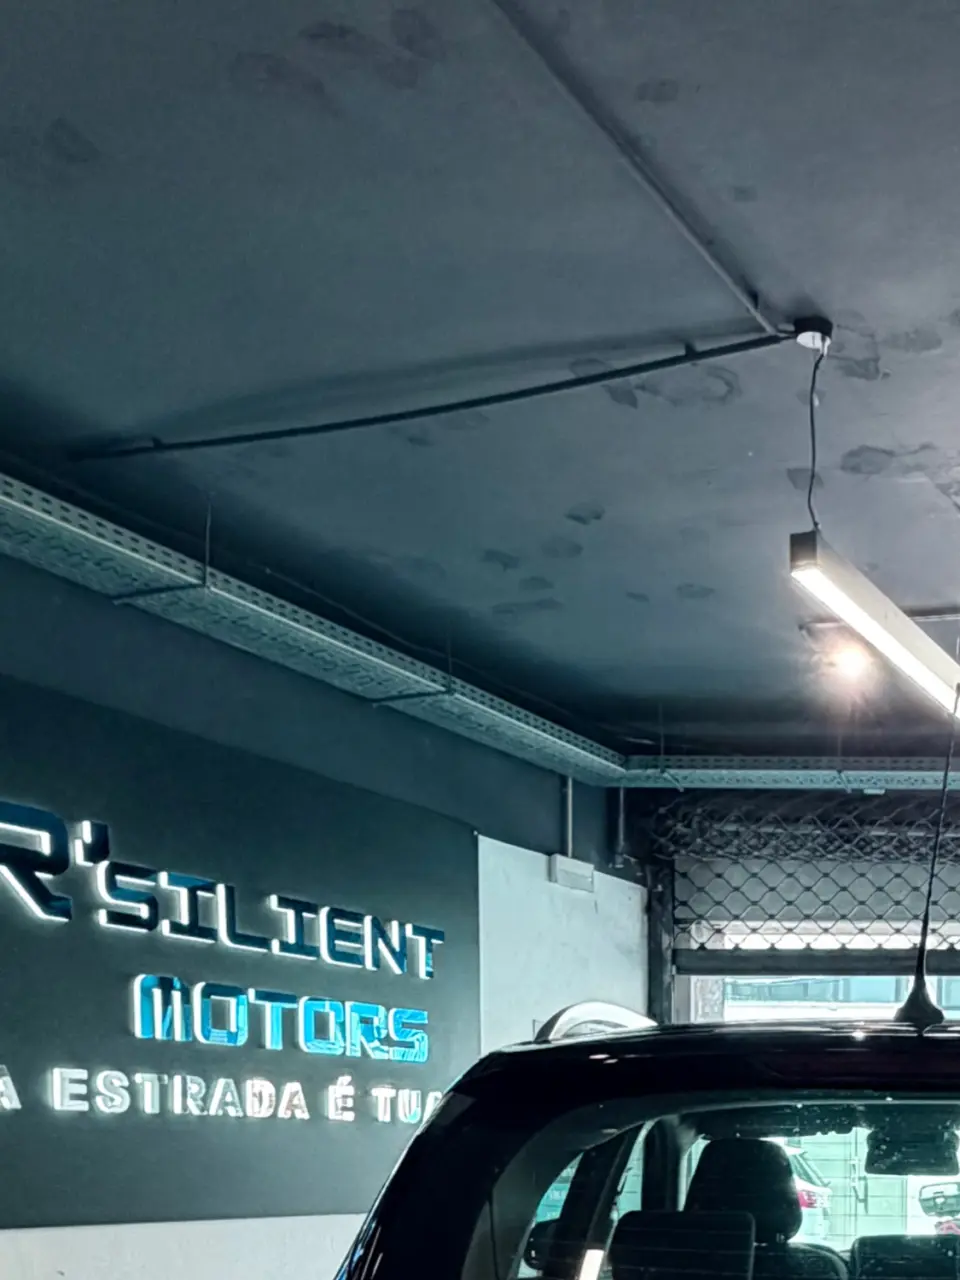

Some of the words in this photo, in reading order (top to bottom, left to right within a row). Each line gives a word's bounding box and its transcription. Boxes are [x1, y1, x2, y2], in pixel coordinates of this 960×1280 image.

[0, 800, 444, 979] R'SILIENT
[134, 974, 429, 1064] MOTORS
[53, 1067, 310, 1120] ESTRADA
[327, 1075, 355, 1121] É
